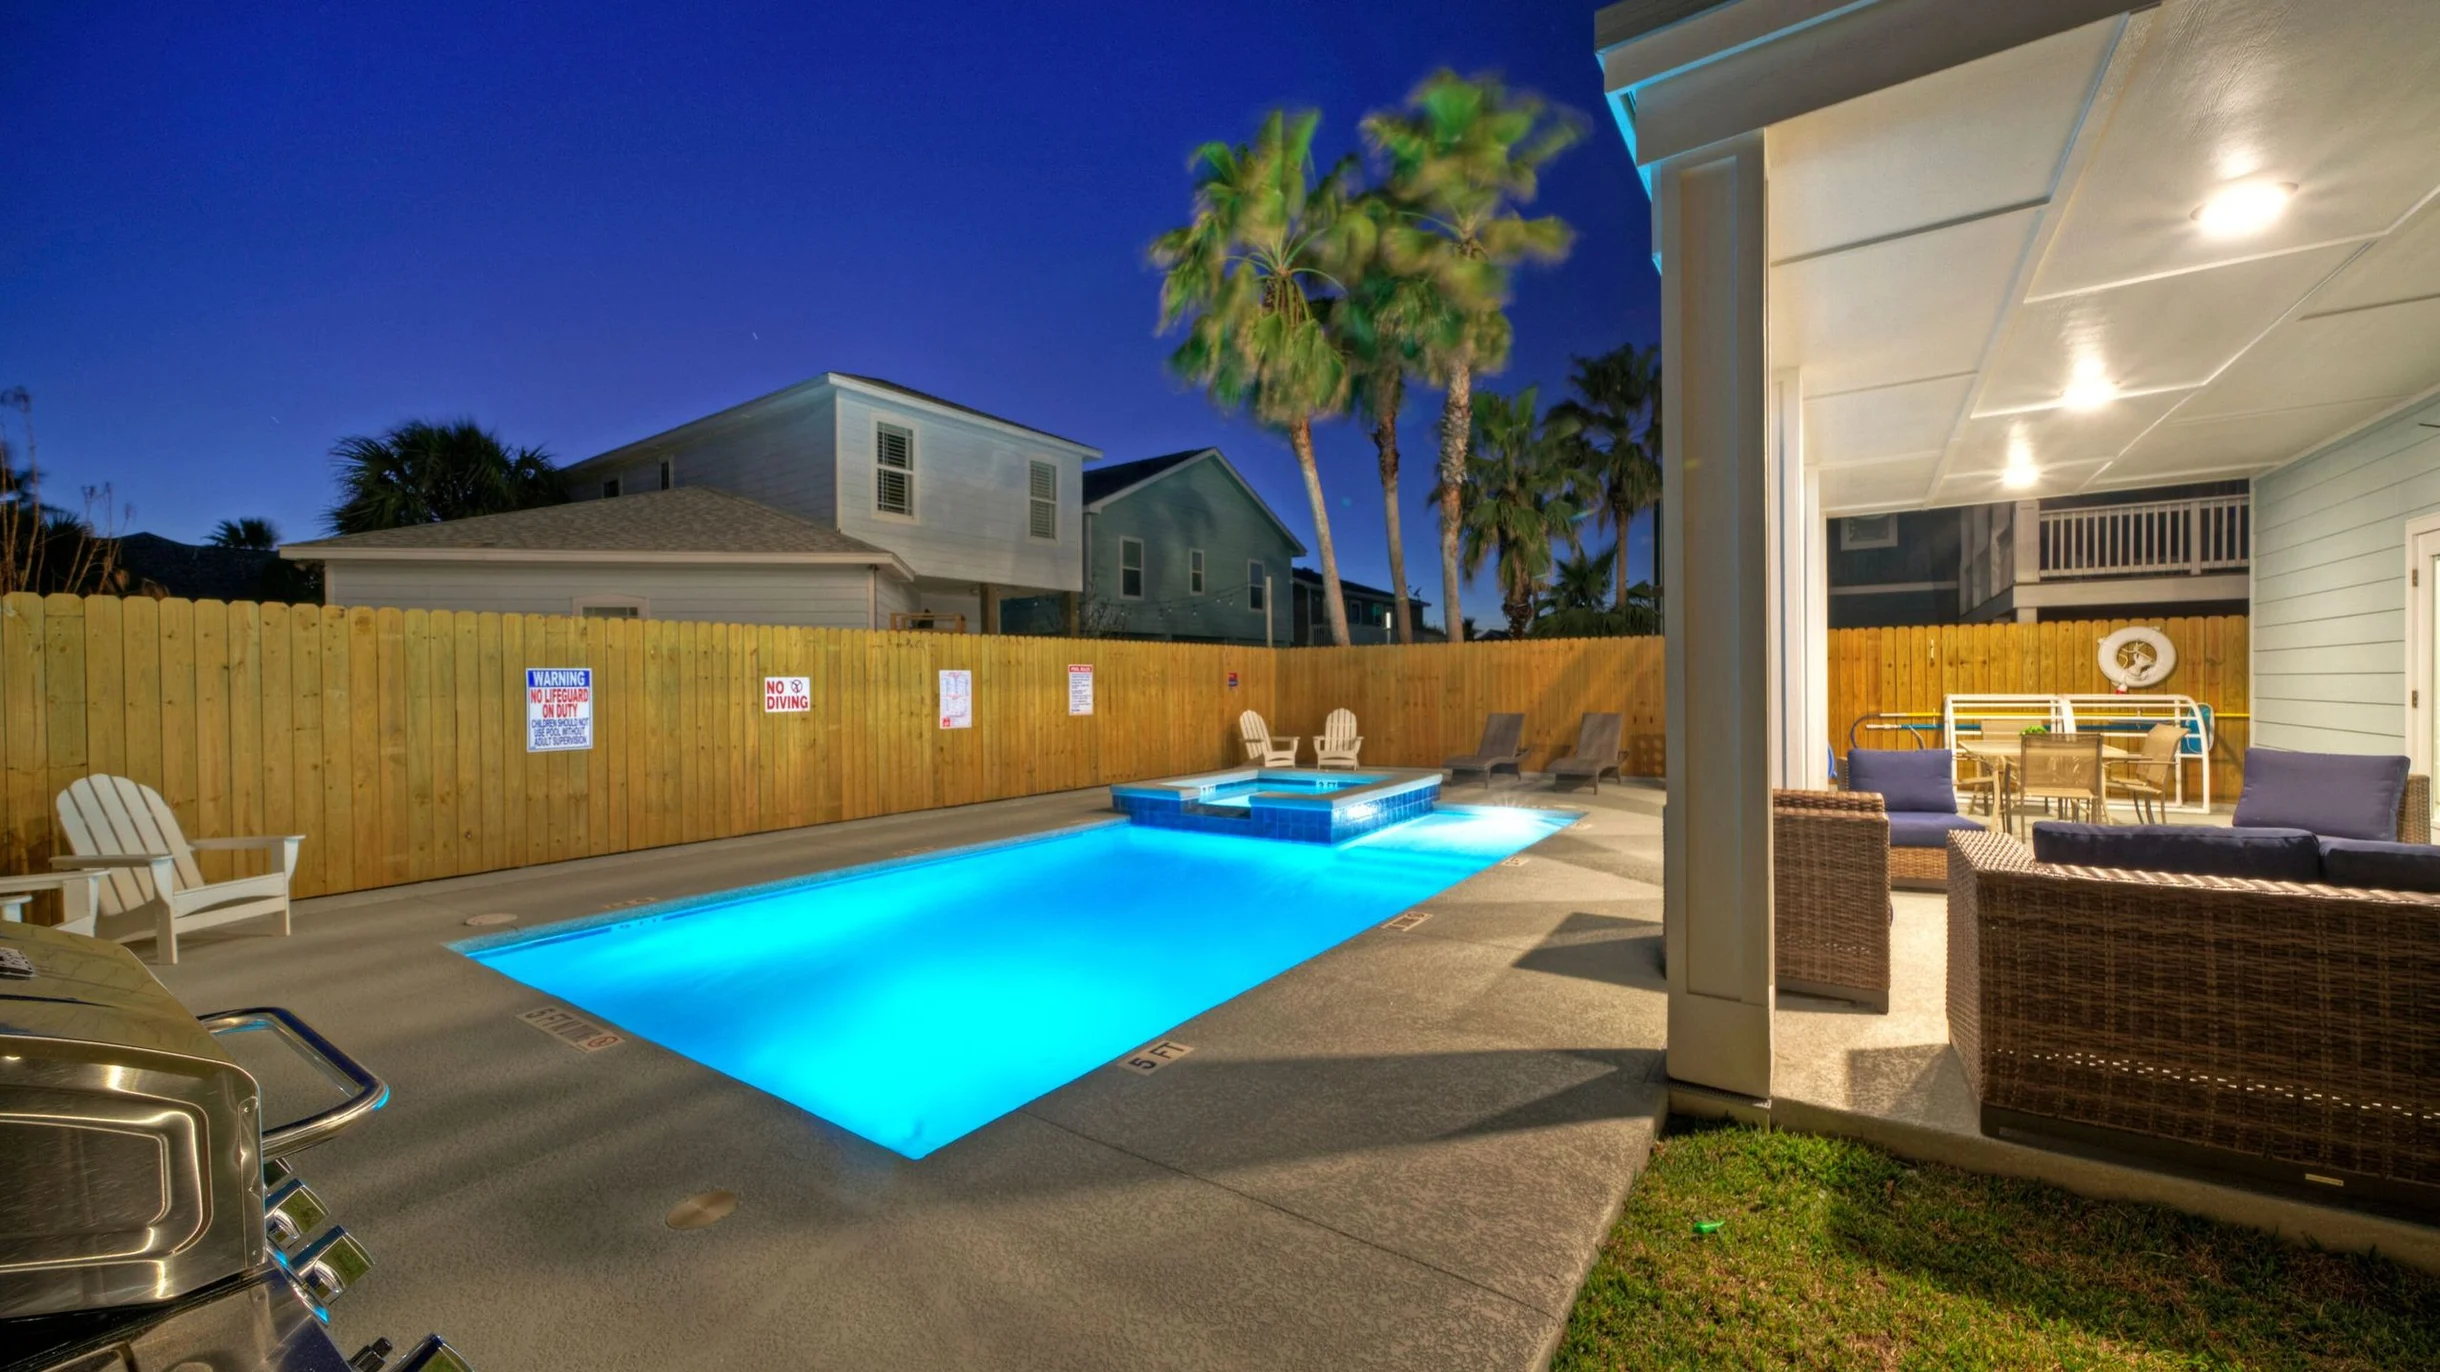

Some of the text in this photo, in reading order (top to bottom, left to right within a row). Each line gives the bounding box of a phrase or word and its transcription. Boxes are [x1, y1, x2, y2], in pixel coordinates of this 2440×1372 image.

[532, 671, 586, 687] WARNING
[766, 680, 785, 694] NO
[530, 688, 589, 704] NO LIFEGUARD
[766, 695, 808, 710] DIVING
[542, 704, 578, 718] ON DUTY
[531, 717, 589, 728] CHILDREN SHOULD NOT
[534, 726, 585, 737] USE POOL WITHOUT
[534, 736, 587, 746] ADULT SUPERVISION
[525, 1007, 557, 1018] 5
[1128, 1042, 1185, 1070] 5 FT
